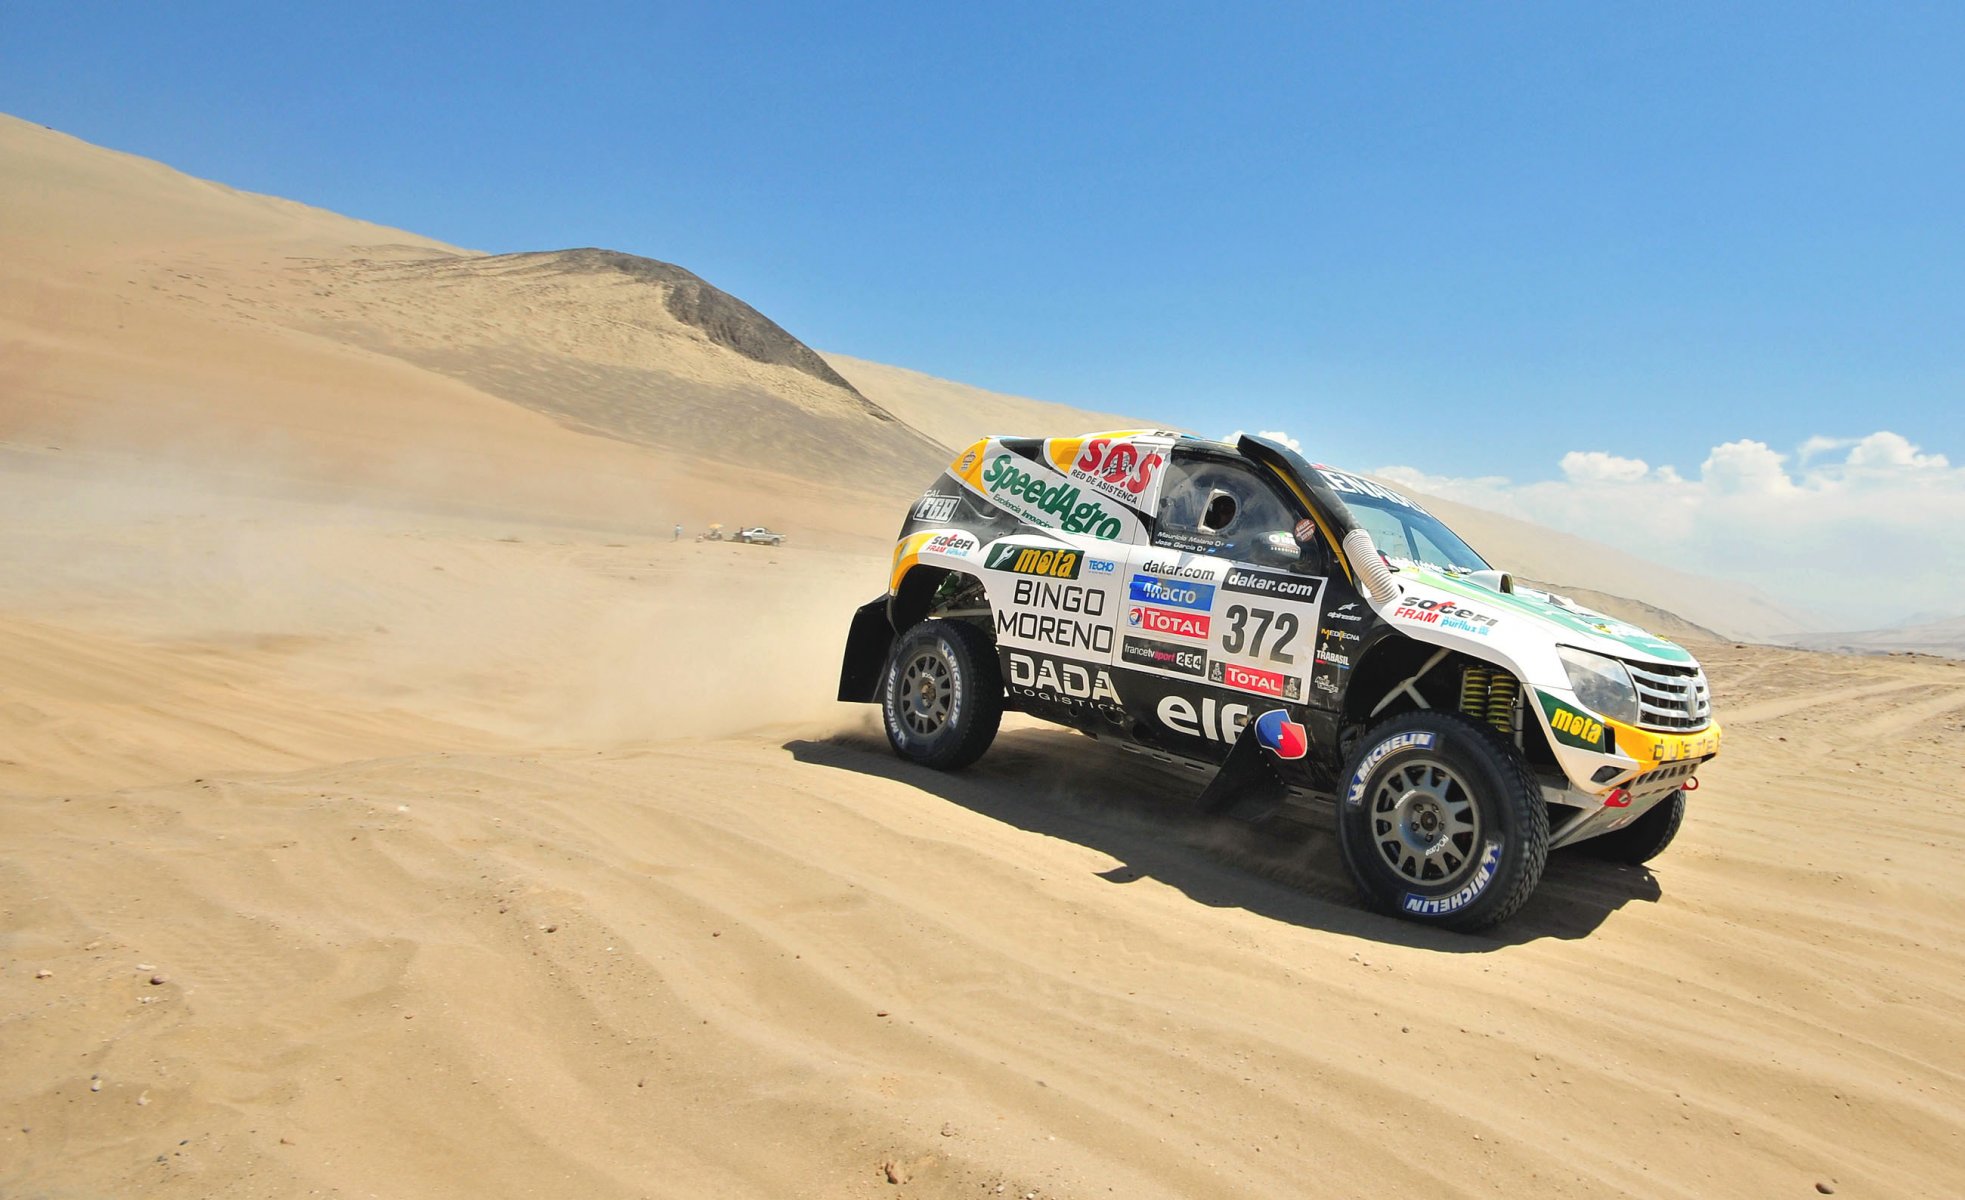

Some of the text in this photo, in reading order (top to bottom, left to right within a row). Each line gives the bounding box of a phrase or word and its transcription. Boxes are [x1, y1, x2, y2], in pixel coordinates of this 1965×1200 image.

[1071, 468, 1089, 482] RED
[1086, 474, 1095, 486] DE
[984, 454, 1121, 540] SpeedAgro
[1013, 548, 1076, 578] mota
[1089, 560, 1115, 572] TECHO
[1143, 559, 1215, 581] dakar.com
[1013, 579, 1105, 616] BINGO
[1228, 571, 1313, 597] dakar.com
[997, 609, 1114, 653] MORENO
[1394, 607, 1440, 624] FRAM
[1222, 604, 1299, 665] 372
[1010, 653, 1123, 705] DADA
[1551, 708, 1602, 744] mota
[1357, 733, 1432, 783] MICHELIN
[1406, 865, 1490, 913] MICHELIN
